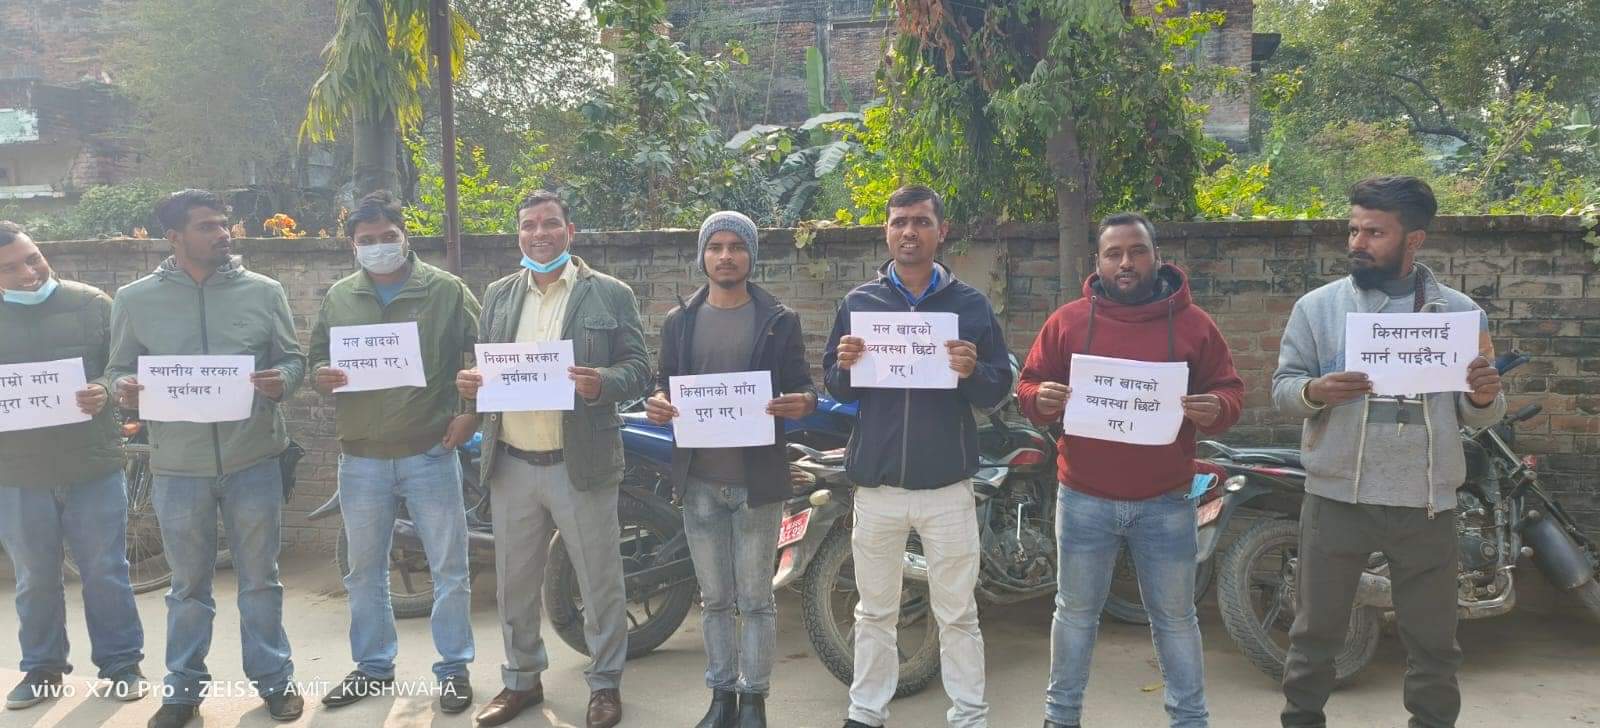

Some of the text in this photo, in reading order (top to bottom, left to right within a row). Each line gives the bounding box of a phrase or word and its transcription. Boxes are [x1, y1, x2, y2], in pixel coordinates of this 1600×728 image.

[872, 321, 933, 335] मल खादको
[1372, 323, 1451, 340] किसानलाई
[342, 332, 400, 348] मल खादको
[912, 342, 937, 355] छिटो
[1360, 348, 1390, 364] मार्न
[337, 358, 378, 369] व्यवस्था
[484, 352, 559, 364] निकामा सरकार
[149, 363, 240, 377] स्थानीय सरकार
[890, 364, 907, 377] गर्
[0, 372, 23, 387] ाम्रो
[1094, 375, 1159, 392] मल खादको
[680, 383, 728, 398] किसानको
[1086, 395, 1161, 412] व्यवस्था छिटो
[695, 407, 713, 422] पुरा
[1108, 420, 1125, 433] गर्
